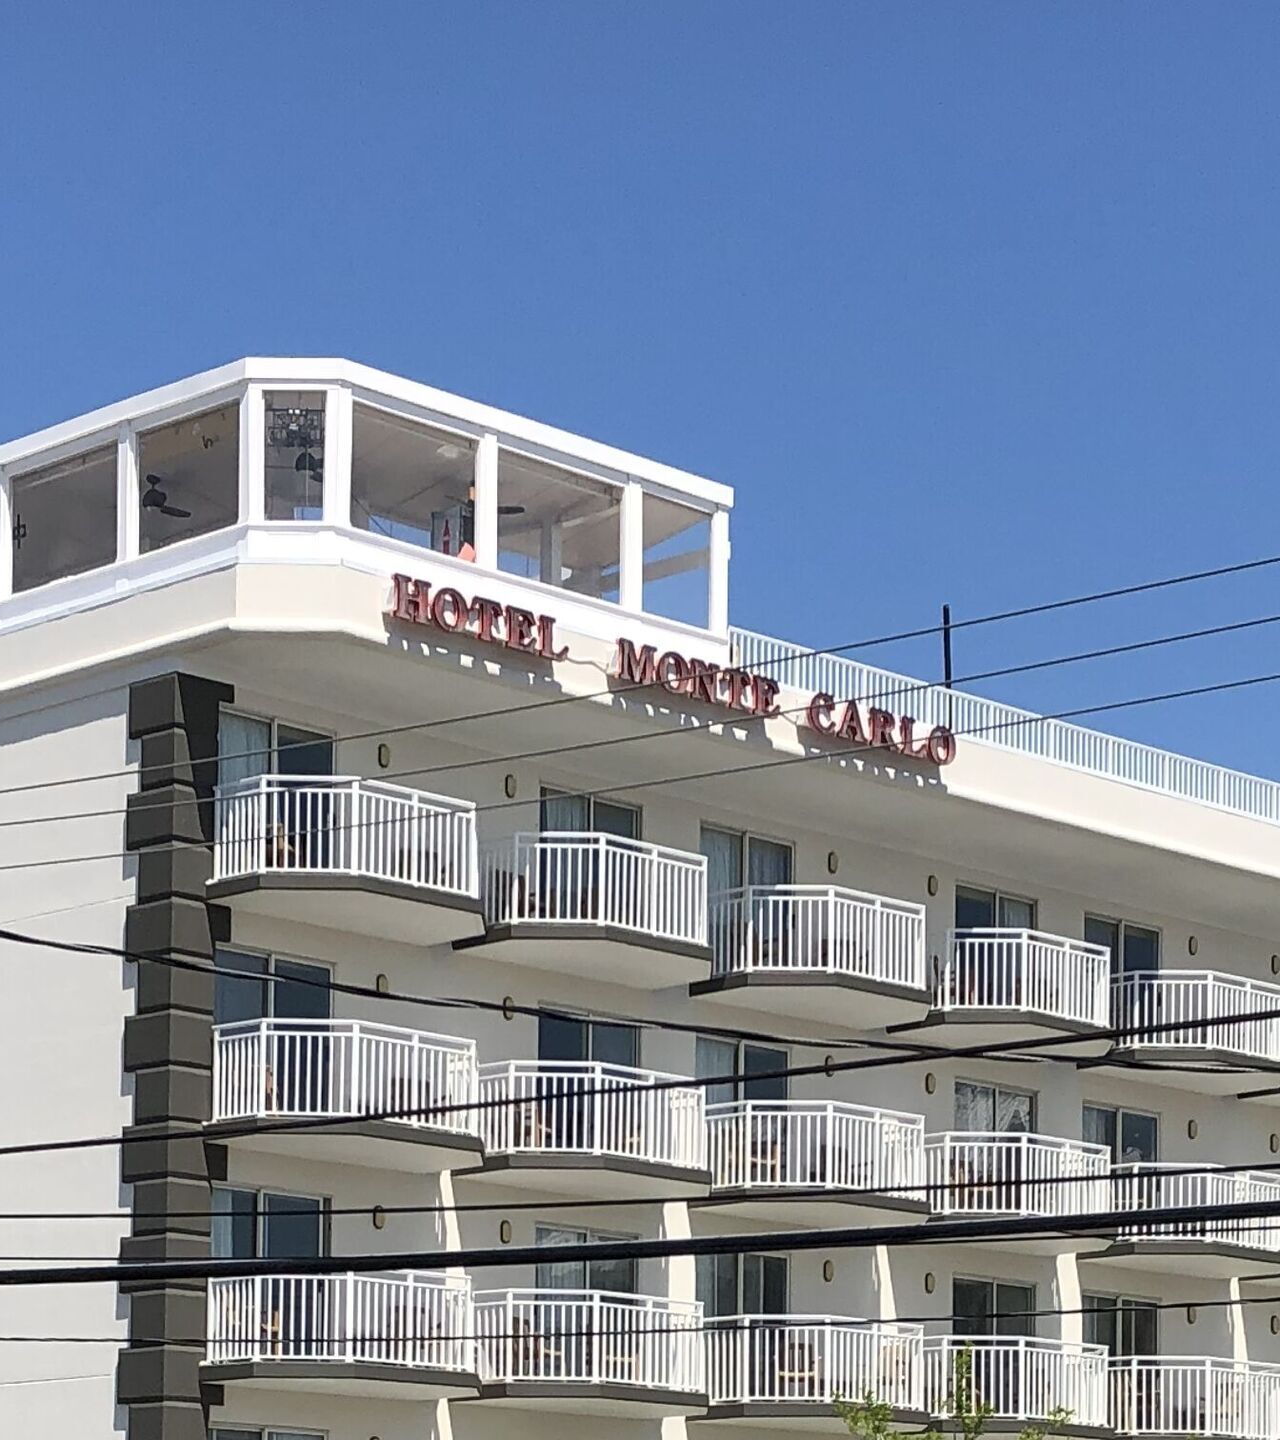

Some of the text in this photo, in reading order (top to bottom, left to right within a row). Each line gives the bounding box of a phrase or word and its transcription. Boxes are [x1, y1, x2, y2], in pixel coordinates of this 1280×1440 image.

[391, 573, 956, 766] HOTEL MONTE CARLO
